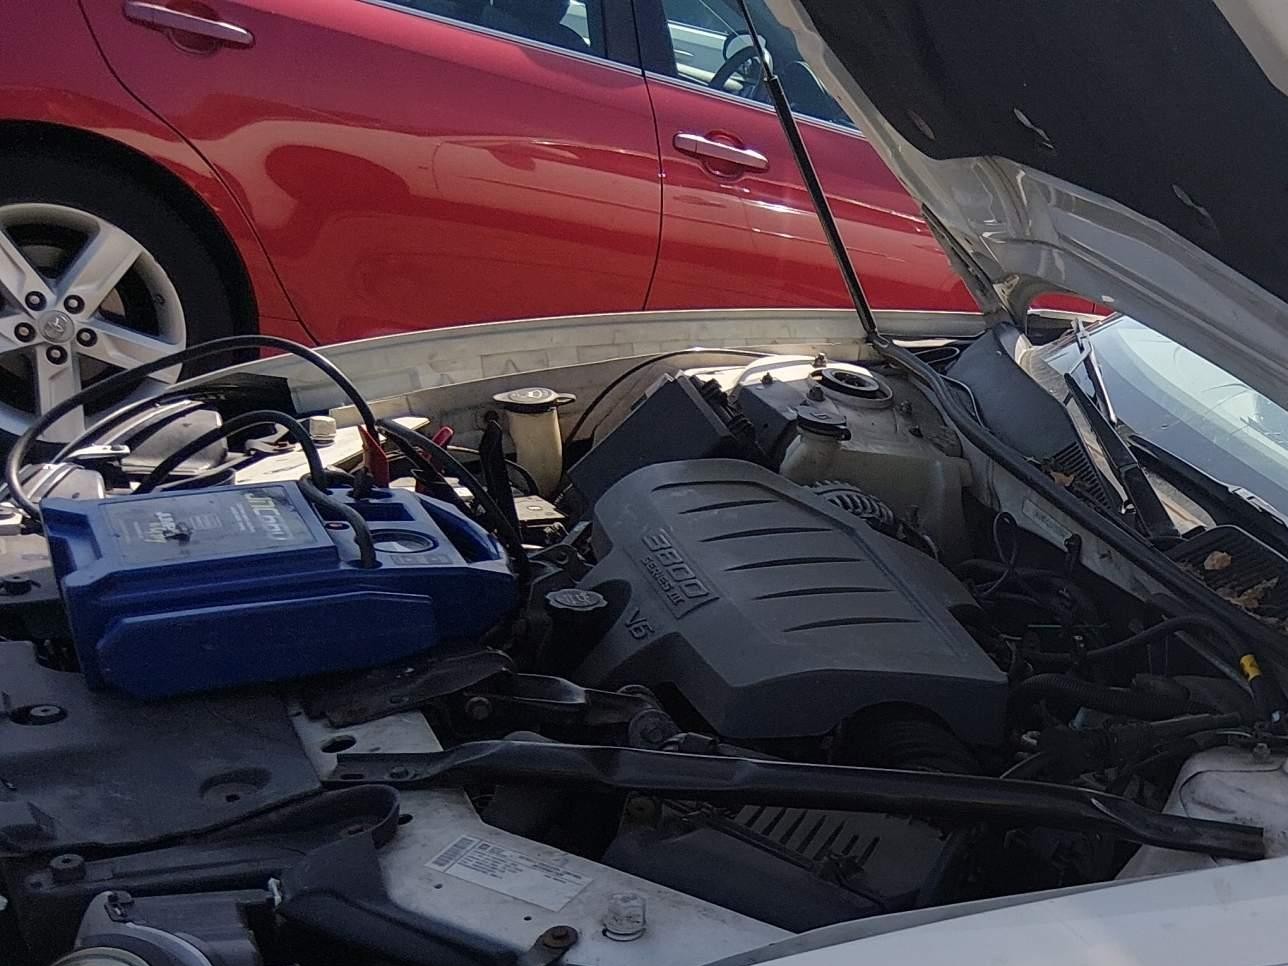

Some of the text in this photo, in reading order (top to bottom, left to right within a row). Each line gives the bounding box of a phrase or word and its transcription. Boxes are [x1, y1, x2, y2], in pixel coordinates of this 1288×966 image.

[641, 528, 710, 599] 3800
[641, 555, 675, 593] SERIES
[624, 607, 656, 640] V6
